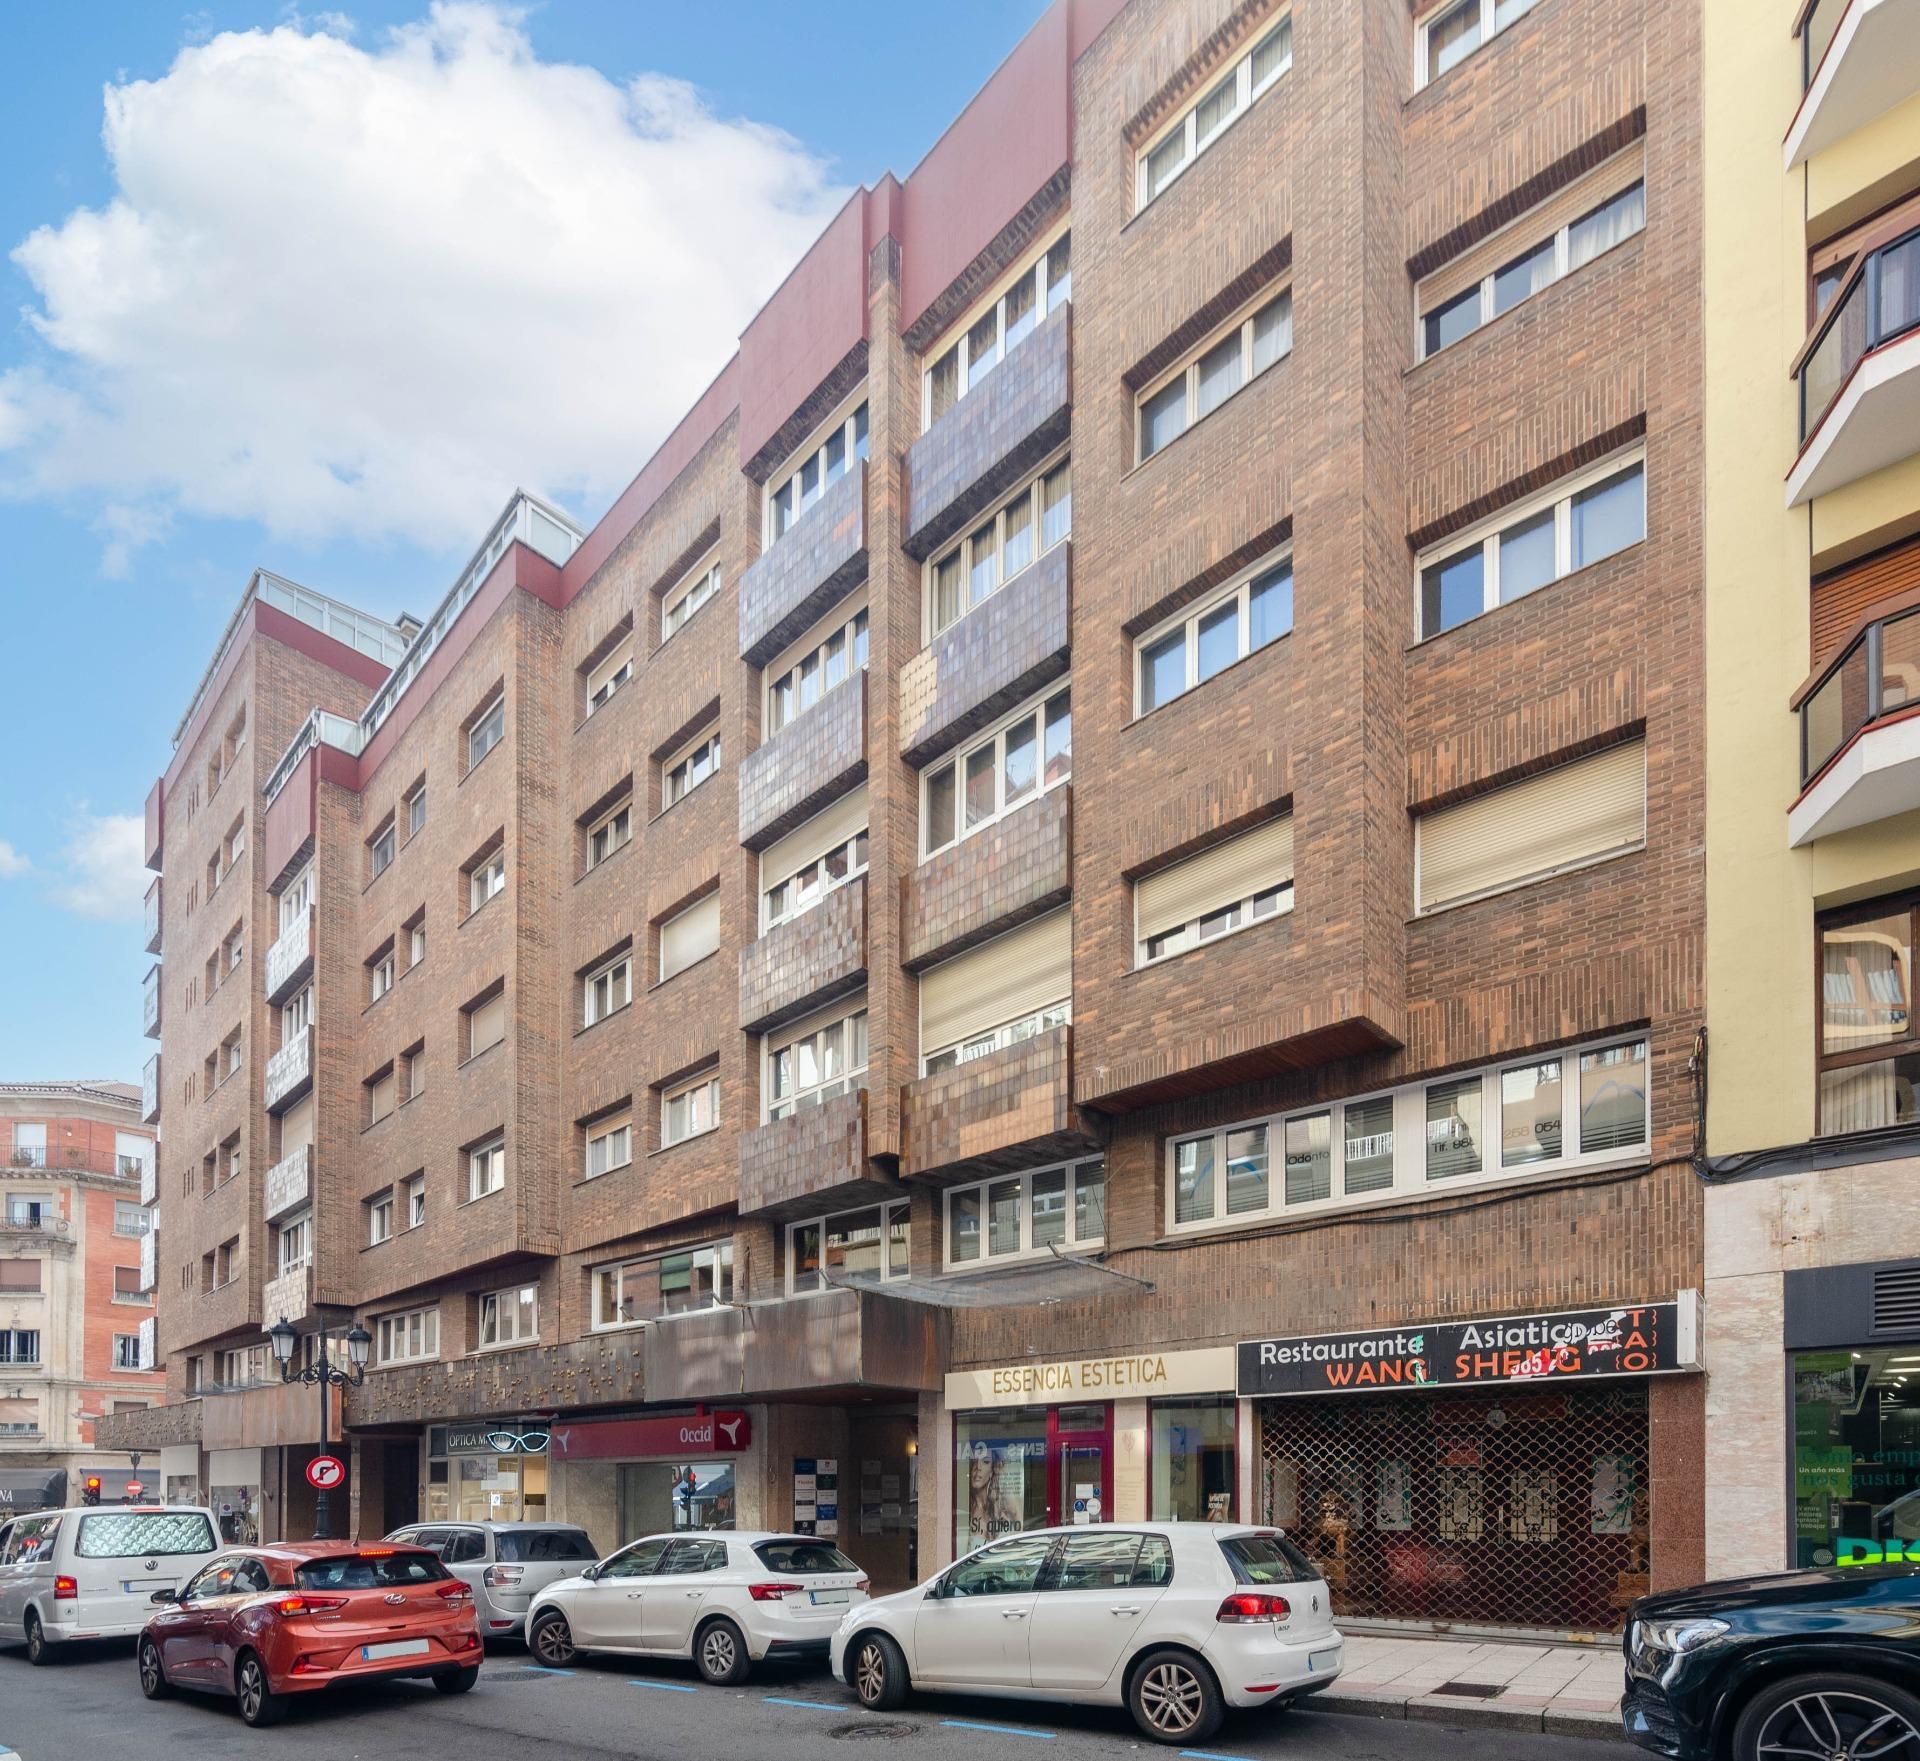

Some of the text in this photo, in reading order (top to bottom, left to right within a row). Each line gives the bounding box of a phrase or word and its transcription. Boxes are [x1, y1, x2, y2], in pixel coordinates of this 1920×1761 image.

[1260, 1333, 1424, 1366] Restaurante
[993, 1366, 1072, 1394] ESSENCIA
[1081, 1356, 1167, 1387] ESTETICA
[1326, 1357, 1427, 1387] WANG
[680, 1425, 711, 1442] Occid
[1848, 1471, 1906, 1489] gusta
[987, 1519, 1022, 1534] quiero
